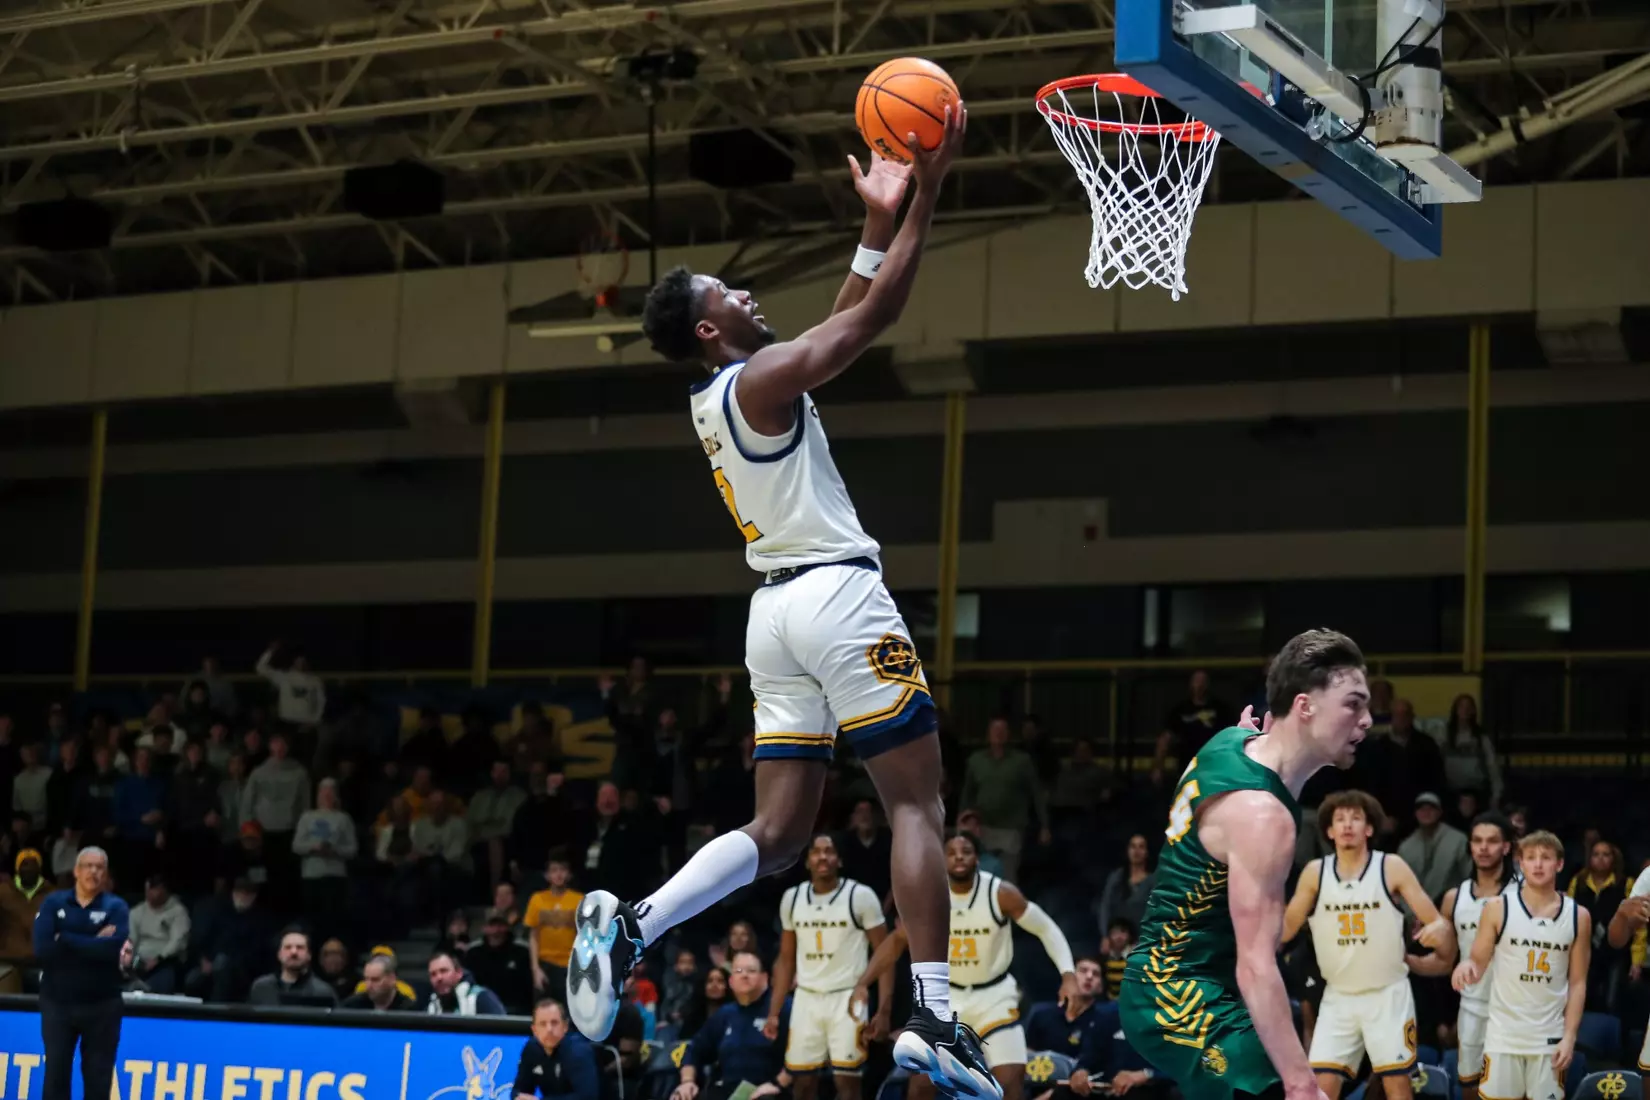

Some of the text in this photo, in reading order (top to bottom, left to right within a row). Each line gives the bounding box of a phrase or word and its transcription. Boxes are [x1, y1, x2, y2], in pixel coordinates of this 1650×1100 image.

[1324, 901, 1380, 912] KANSAS
[794, 920, 848, 928] KANSAS
[1337, 912, 1366, 937] 35
[816, 930, 824, 953] 1
[1337, 937, 1368, 947] CITY
[1509, 938, 1569, 952] KANSAS
[949, 938, 977, 959] 23
[805, 952, 834, 961] CITY
[1527, 949, 1551, 974] 14
[1519, 973, 1554, 984] CITY
